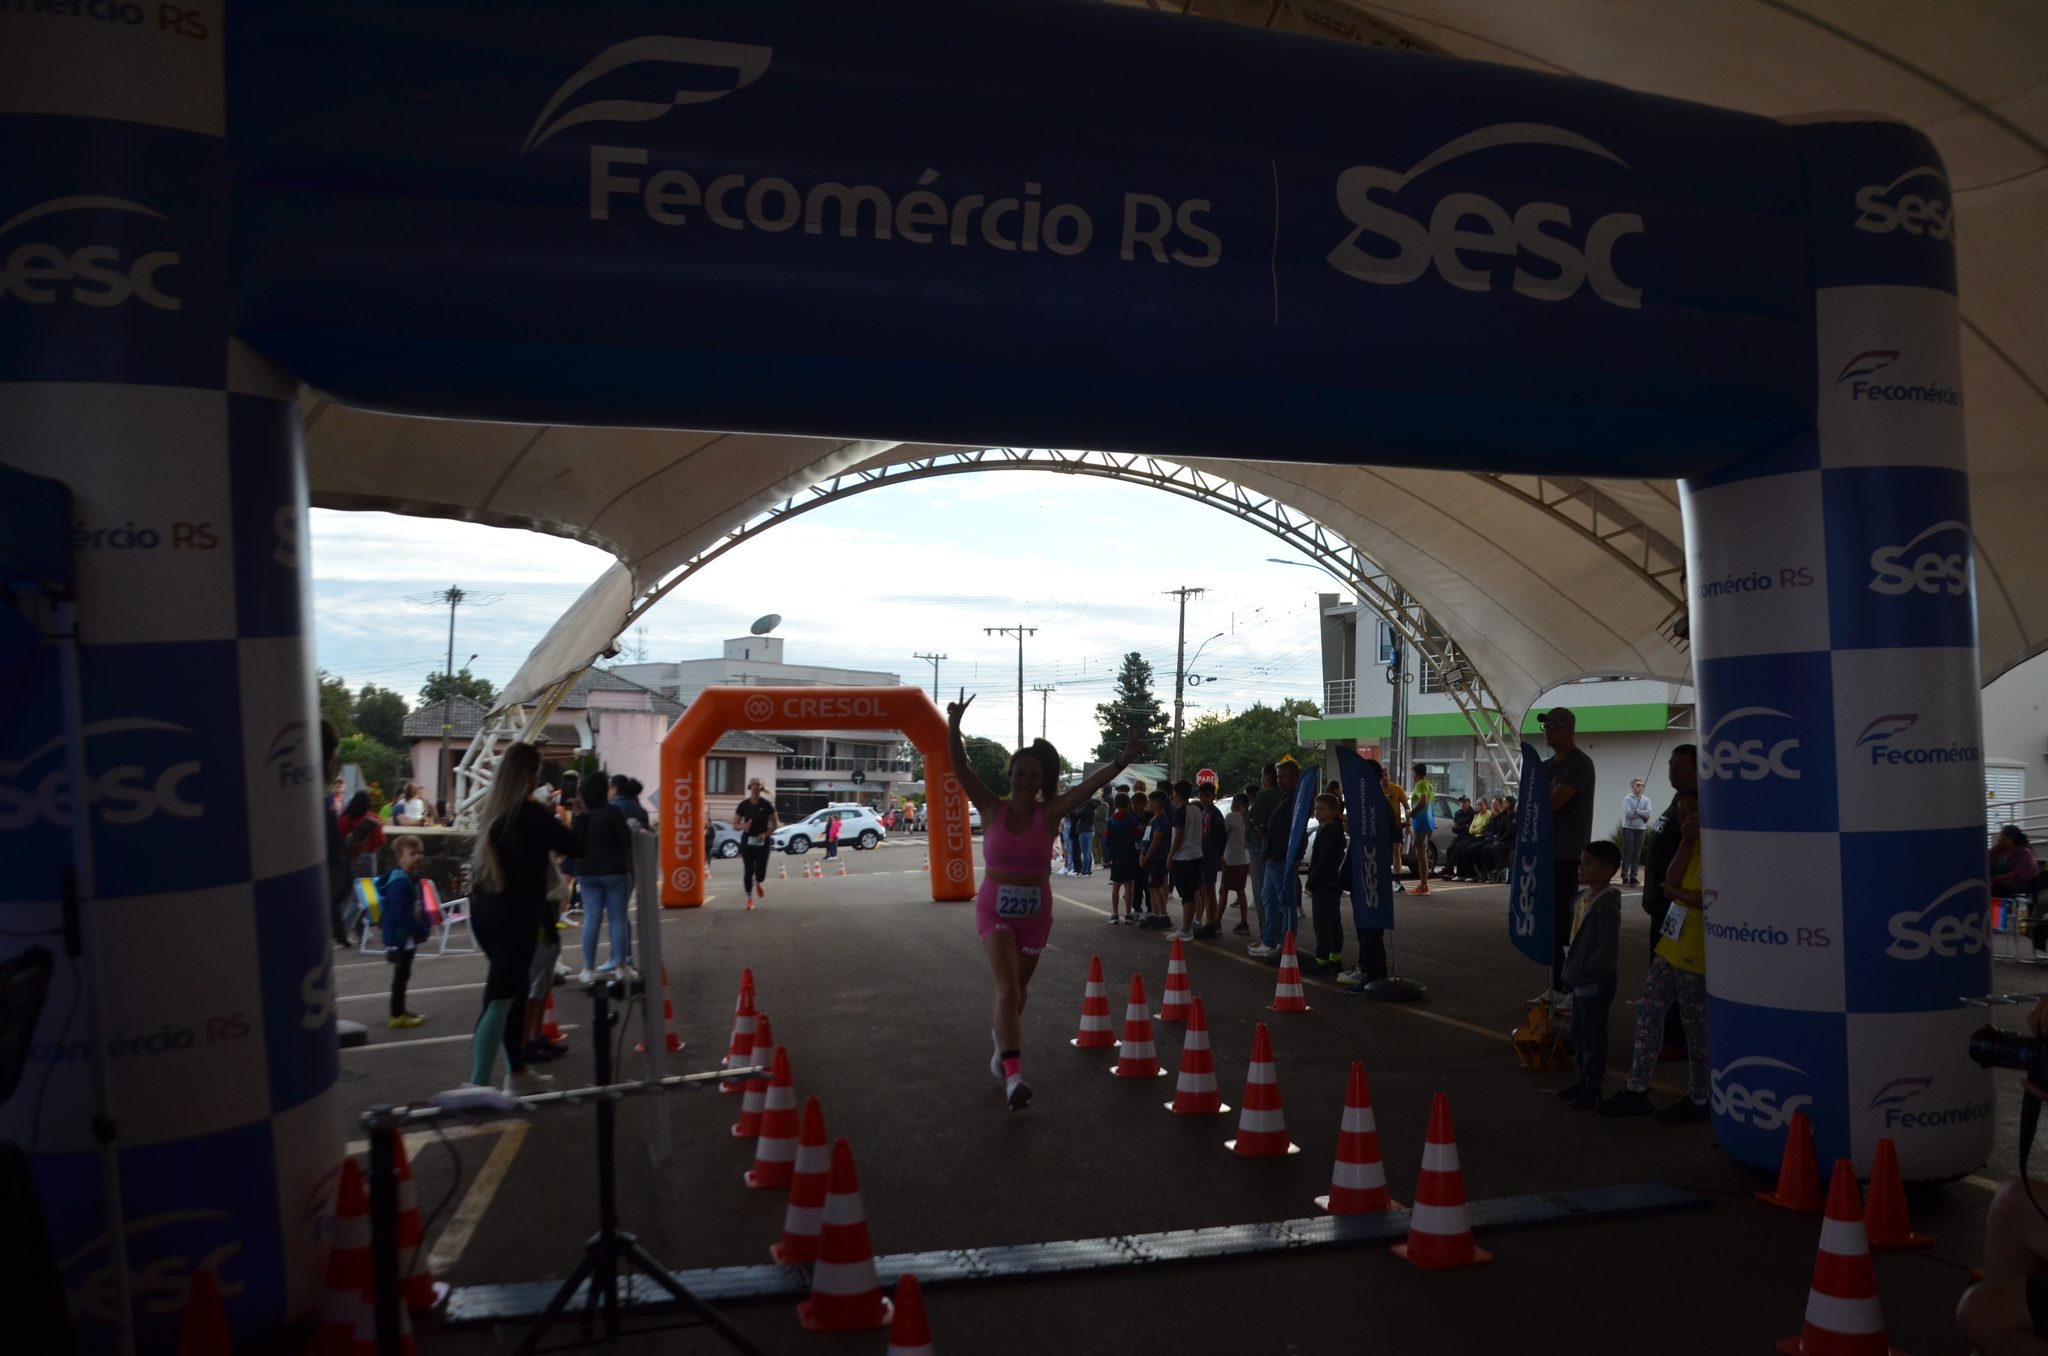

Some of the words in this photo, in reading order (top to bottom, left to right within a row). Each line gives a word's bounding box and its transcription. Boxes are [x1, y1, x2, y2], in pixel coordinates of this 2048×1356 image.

[158, 3, 209, 40] RS
[589, 144, 1094, 257] Fecomércio
[1120, 192, 1224, 269] RS
[1325, 160, 1646, 310] Sesc
[0, 242, 182, 311] esc
[171, 521, 218, 551] RS
[1780, 567, 1815, 590] RS
[1868, 546, 1972, 596] Ses
[782, 696, 887, 719] CRESOL
[1197, 775, 1216, 783] PARE
[673, 771, 693, 861] CRESOL
[1362, 845, 1380, 911] Sesc
[1515, 855, 1538, 937] Sesc
[999, 896, 1038, 915] 2237
[1796, 927, 1831, 948] RS
